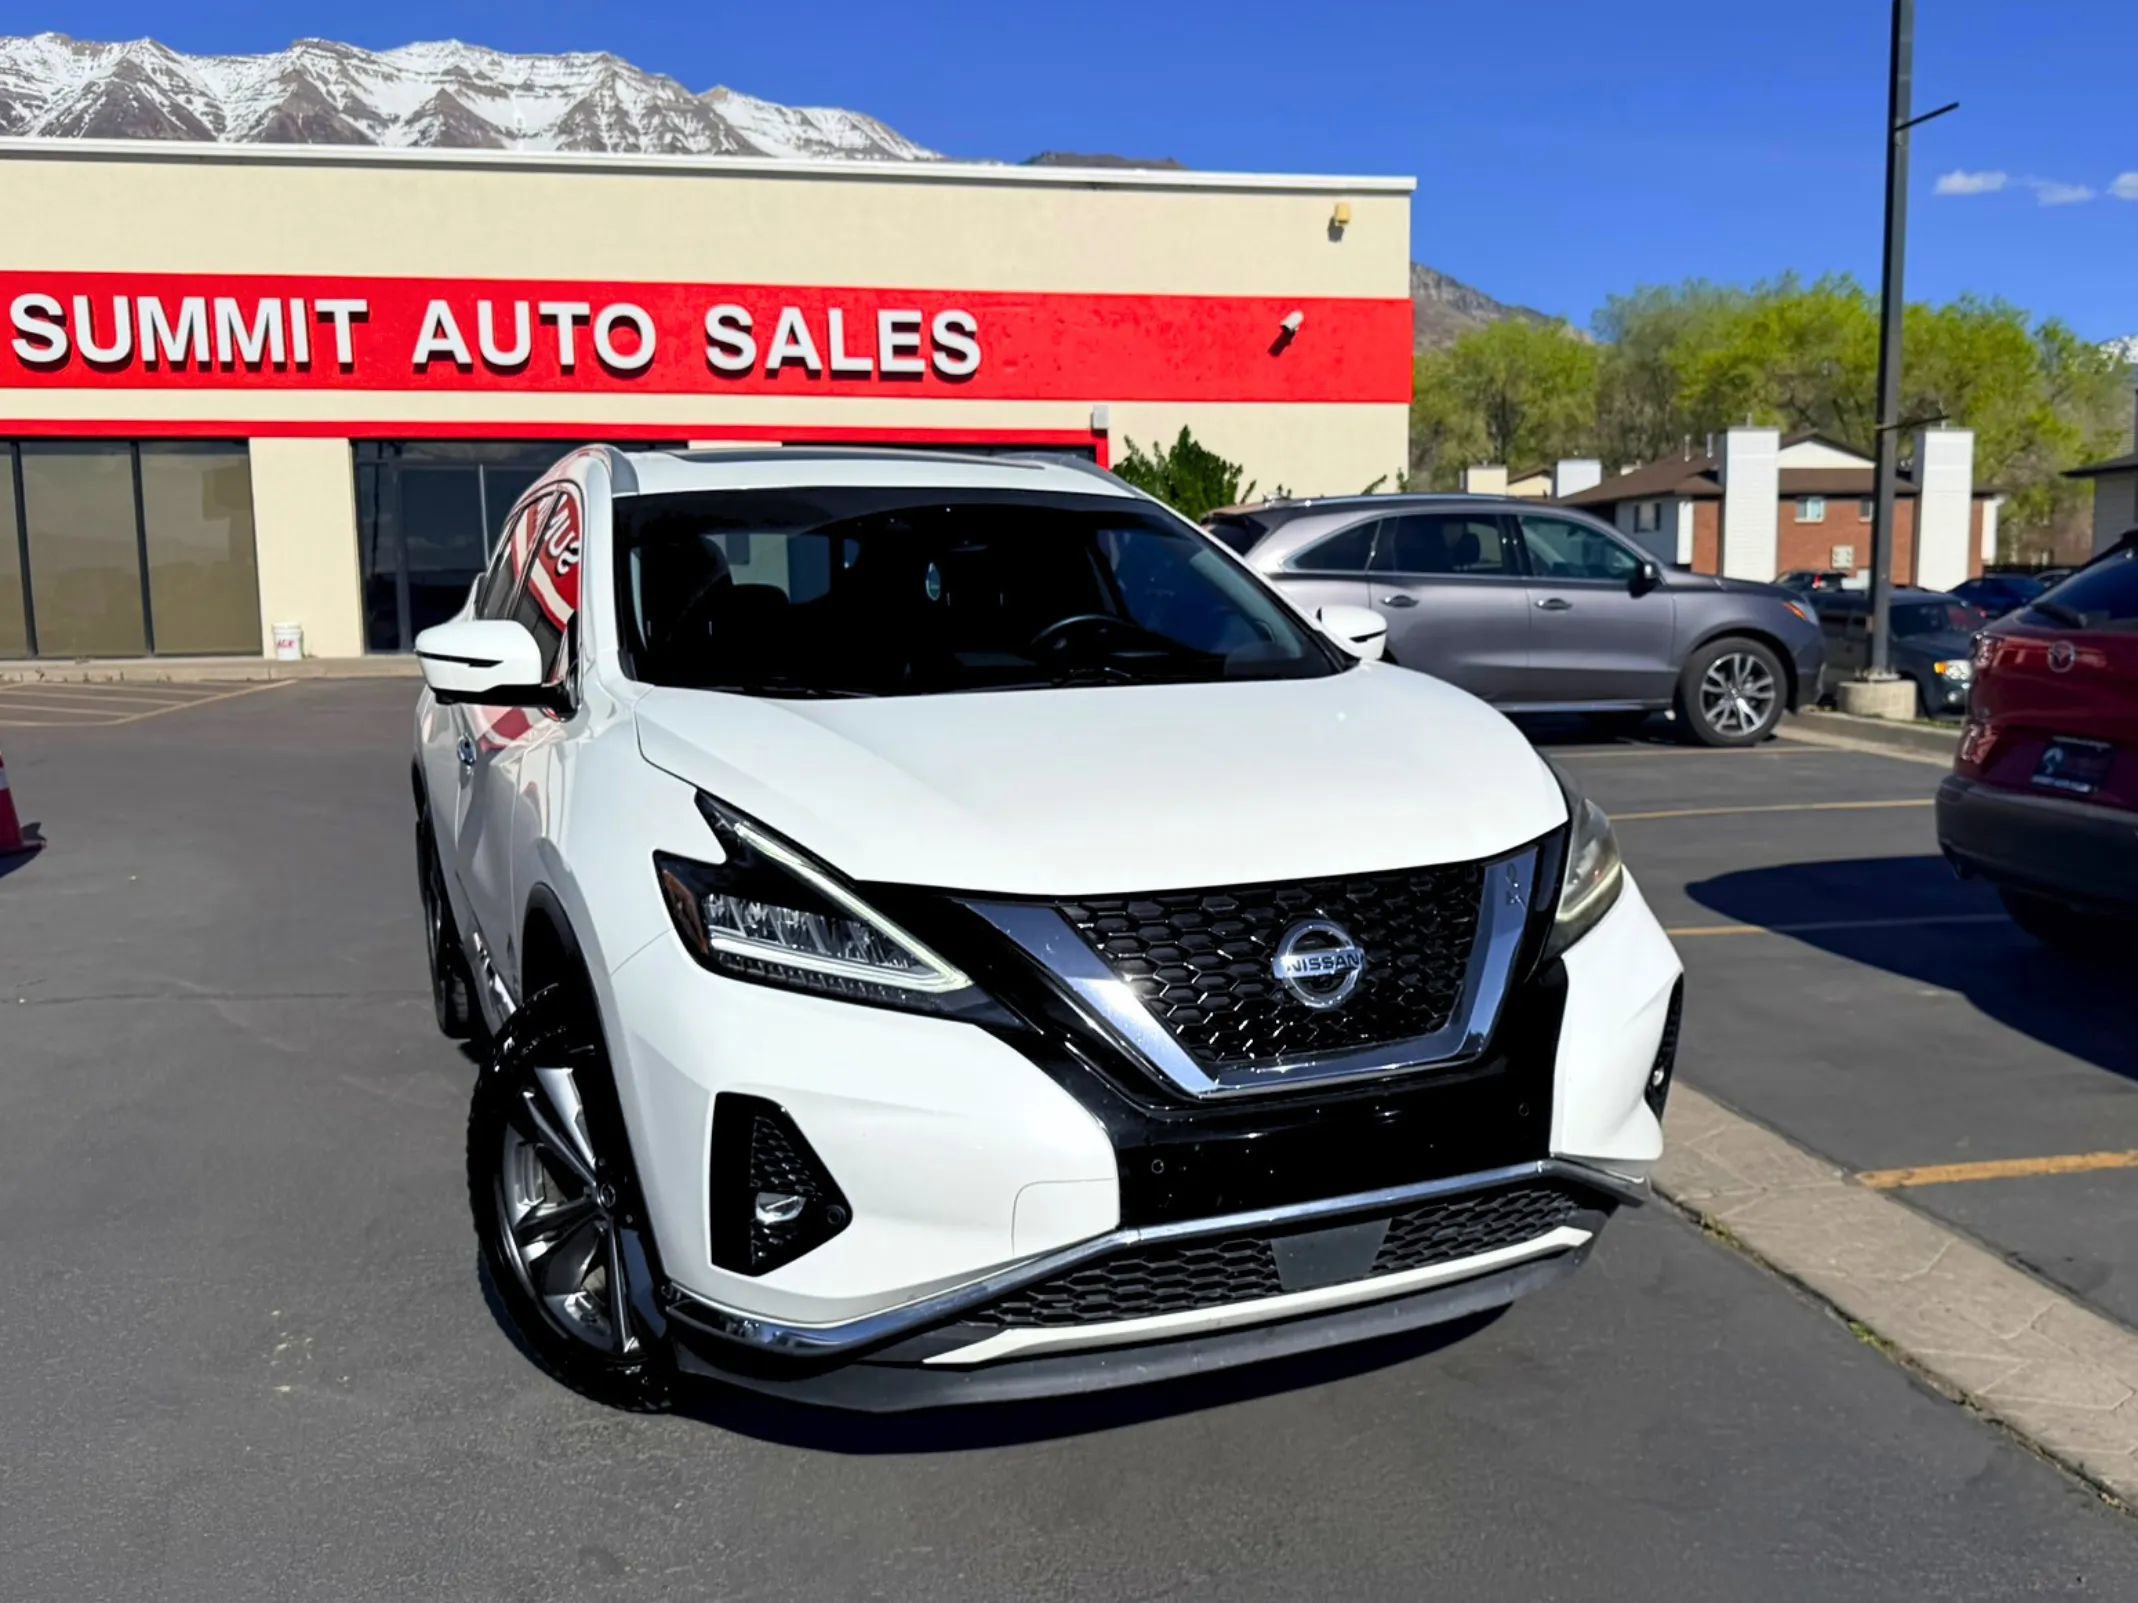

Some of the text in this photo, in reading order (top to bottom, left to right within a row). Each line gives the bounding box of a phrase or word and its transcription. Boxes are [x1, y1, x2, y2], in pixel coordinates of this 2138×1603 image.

[9, 293, 982, 378] SUMMIT AUTO SALES
[1286, 953, 1360, 973] NISSAN
